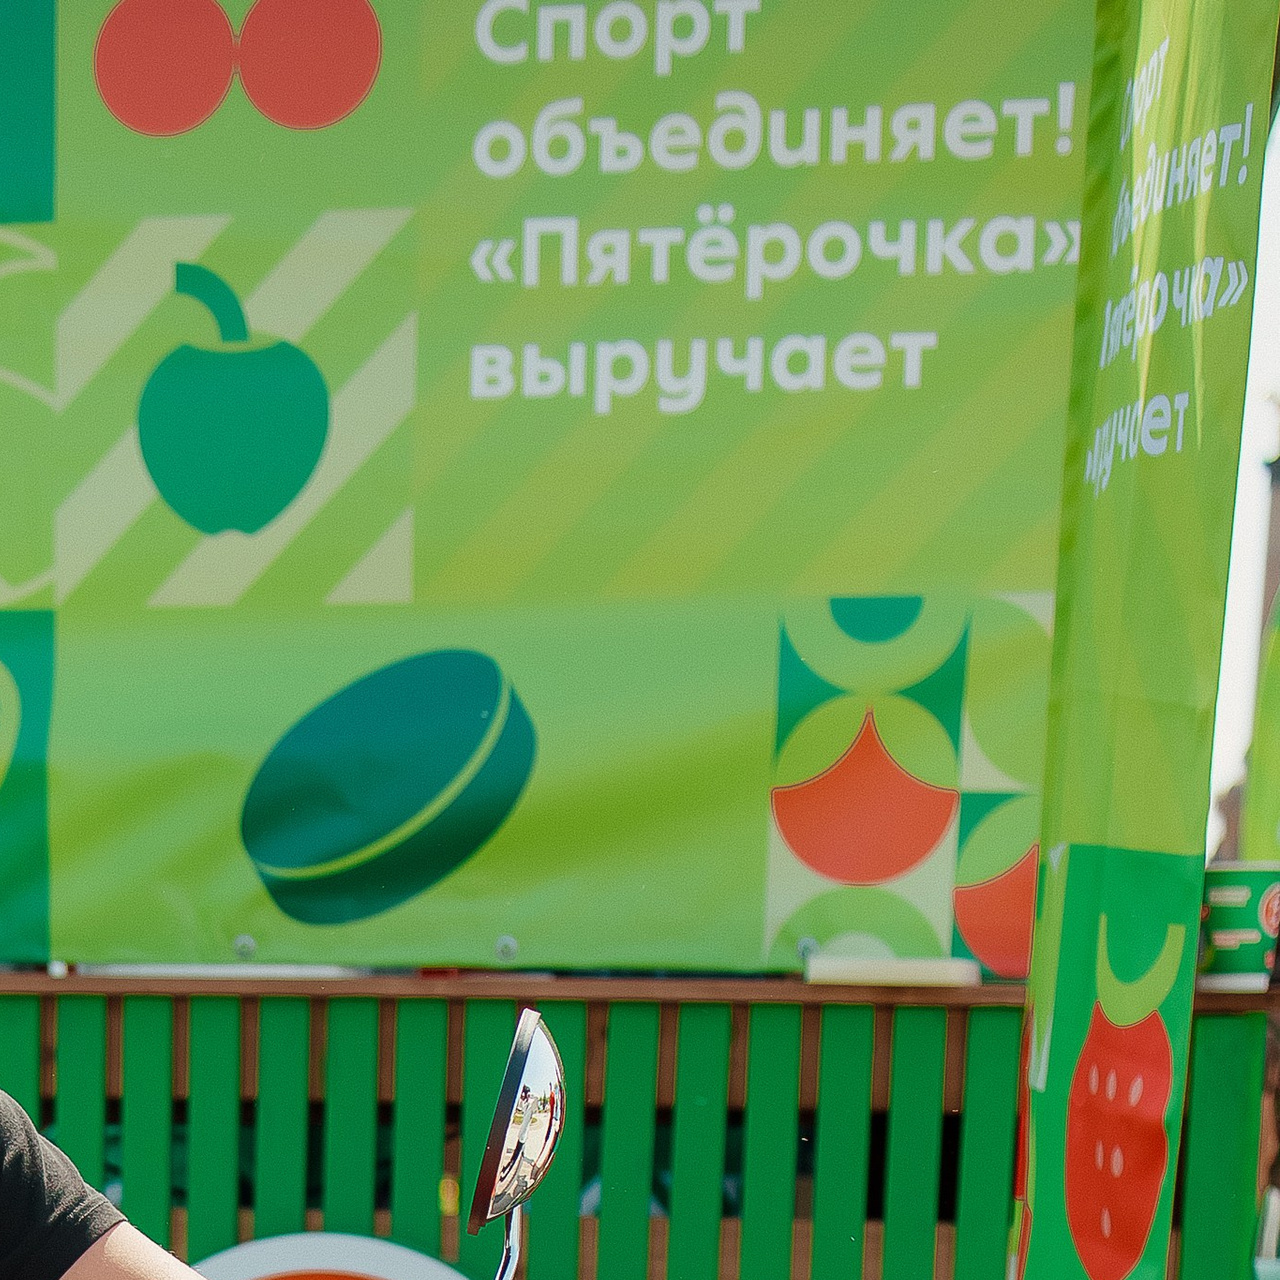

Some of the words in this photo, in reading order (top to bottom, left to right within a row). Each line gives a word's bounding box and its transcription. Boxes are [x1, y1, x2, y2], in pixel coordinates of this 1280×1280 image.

[474, 0, 763, 77] Спорт
[472, 80, 1077, 179] объединяет!
[469, 202, 1081, 301] «Пятёрочка»
[470, 330, 938, 415] выручает
